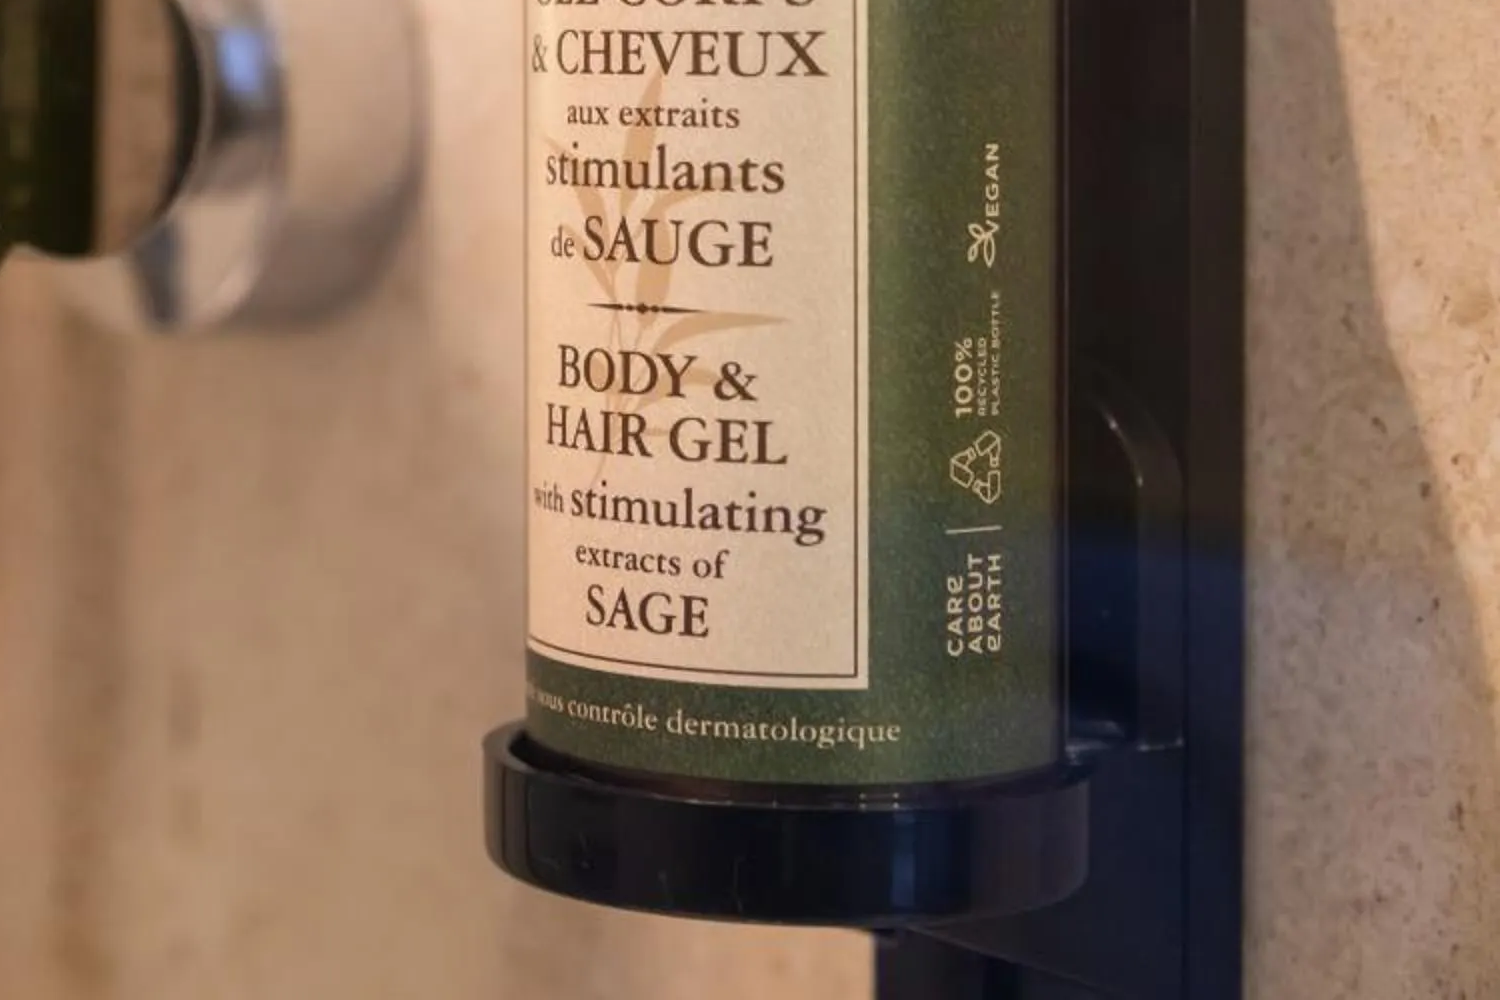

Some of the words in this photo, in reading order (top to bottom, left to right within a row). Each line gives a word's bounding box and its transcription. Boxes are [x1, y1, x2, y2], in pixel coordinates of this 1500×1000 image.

[532, 34, 548, 73] &
[557, 29, 830, 77] CHEVEUX
[567, 104, 609, 126] aux
[619, 99, 740, 129] extraits
[546, 142, 785, 194] stimulants
[984, 142, 1000, 235] VEGAN
[551, 226, 575, 259] de
[583, 215, 773, 267] SAUGE
[558, 345, 696, 398] BODY
[714, 362, 758, 401] &
[954, 337, 973, 419] 100%
[547, 404, 653, 459] HAIR
[669, 417, 787, 466] GEL
[534, 480, 564, 513] with
[571, 480, 827, 547] stimulating
[575, 544, 681, 577] extracts
[693, 551, 729, 579] of
[586, 584, 709, 638] SAGE
[967, 553, 984, 654] ABOUT
[567, 700, 658, 731] contrôle
[666, 708, 901, 749] dermatologique
